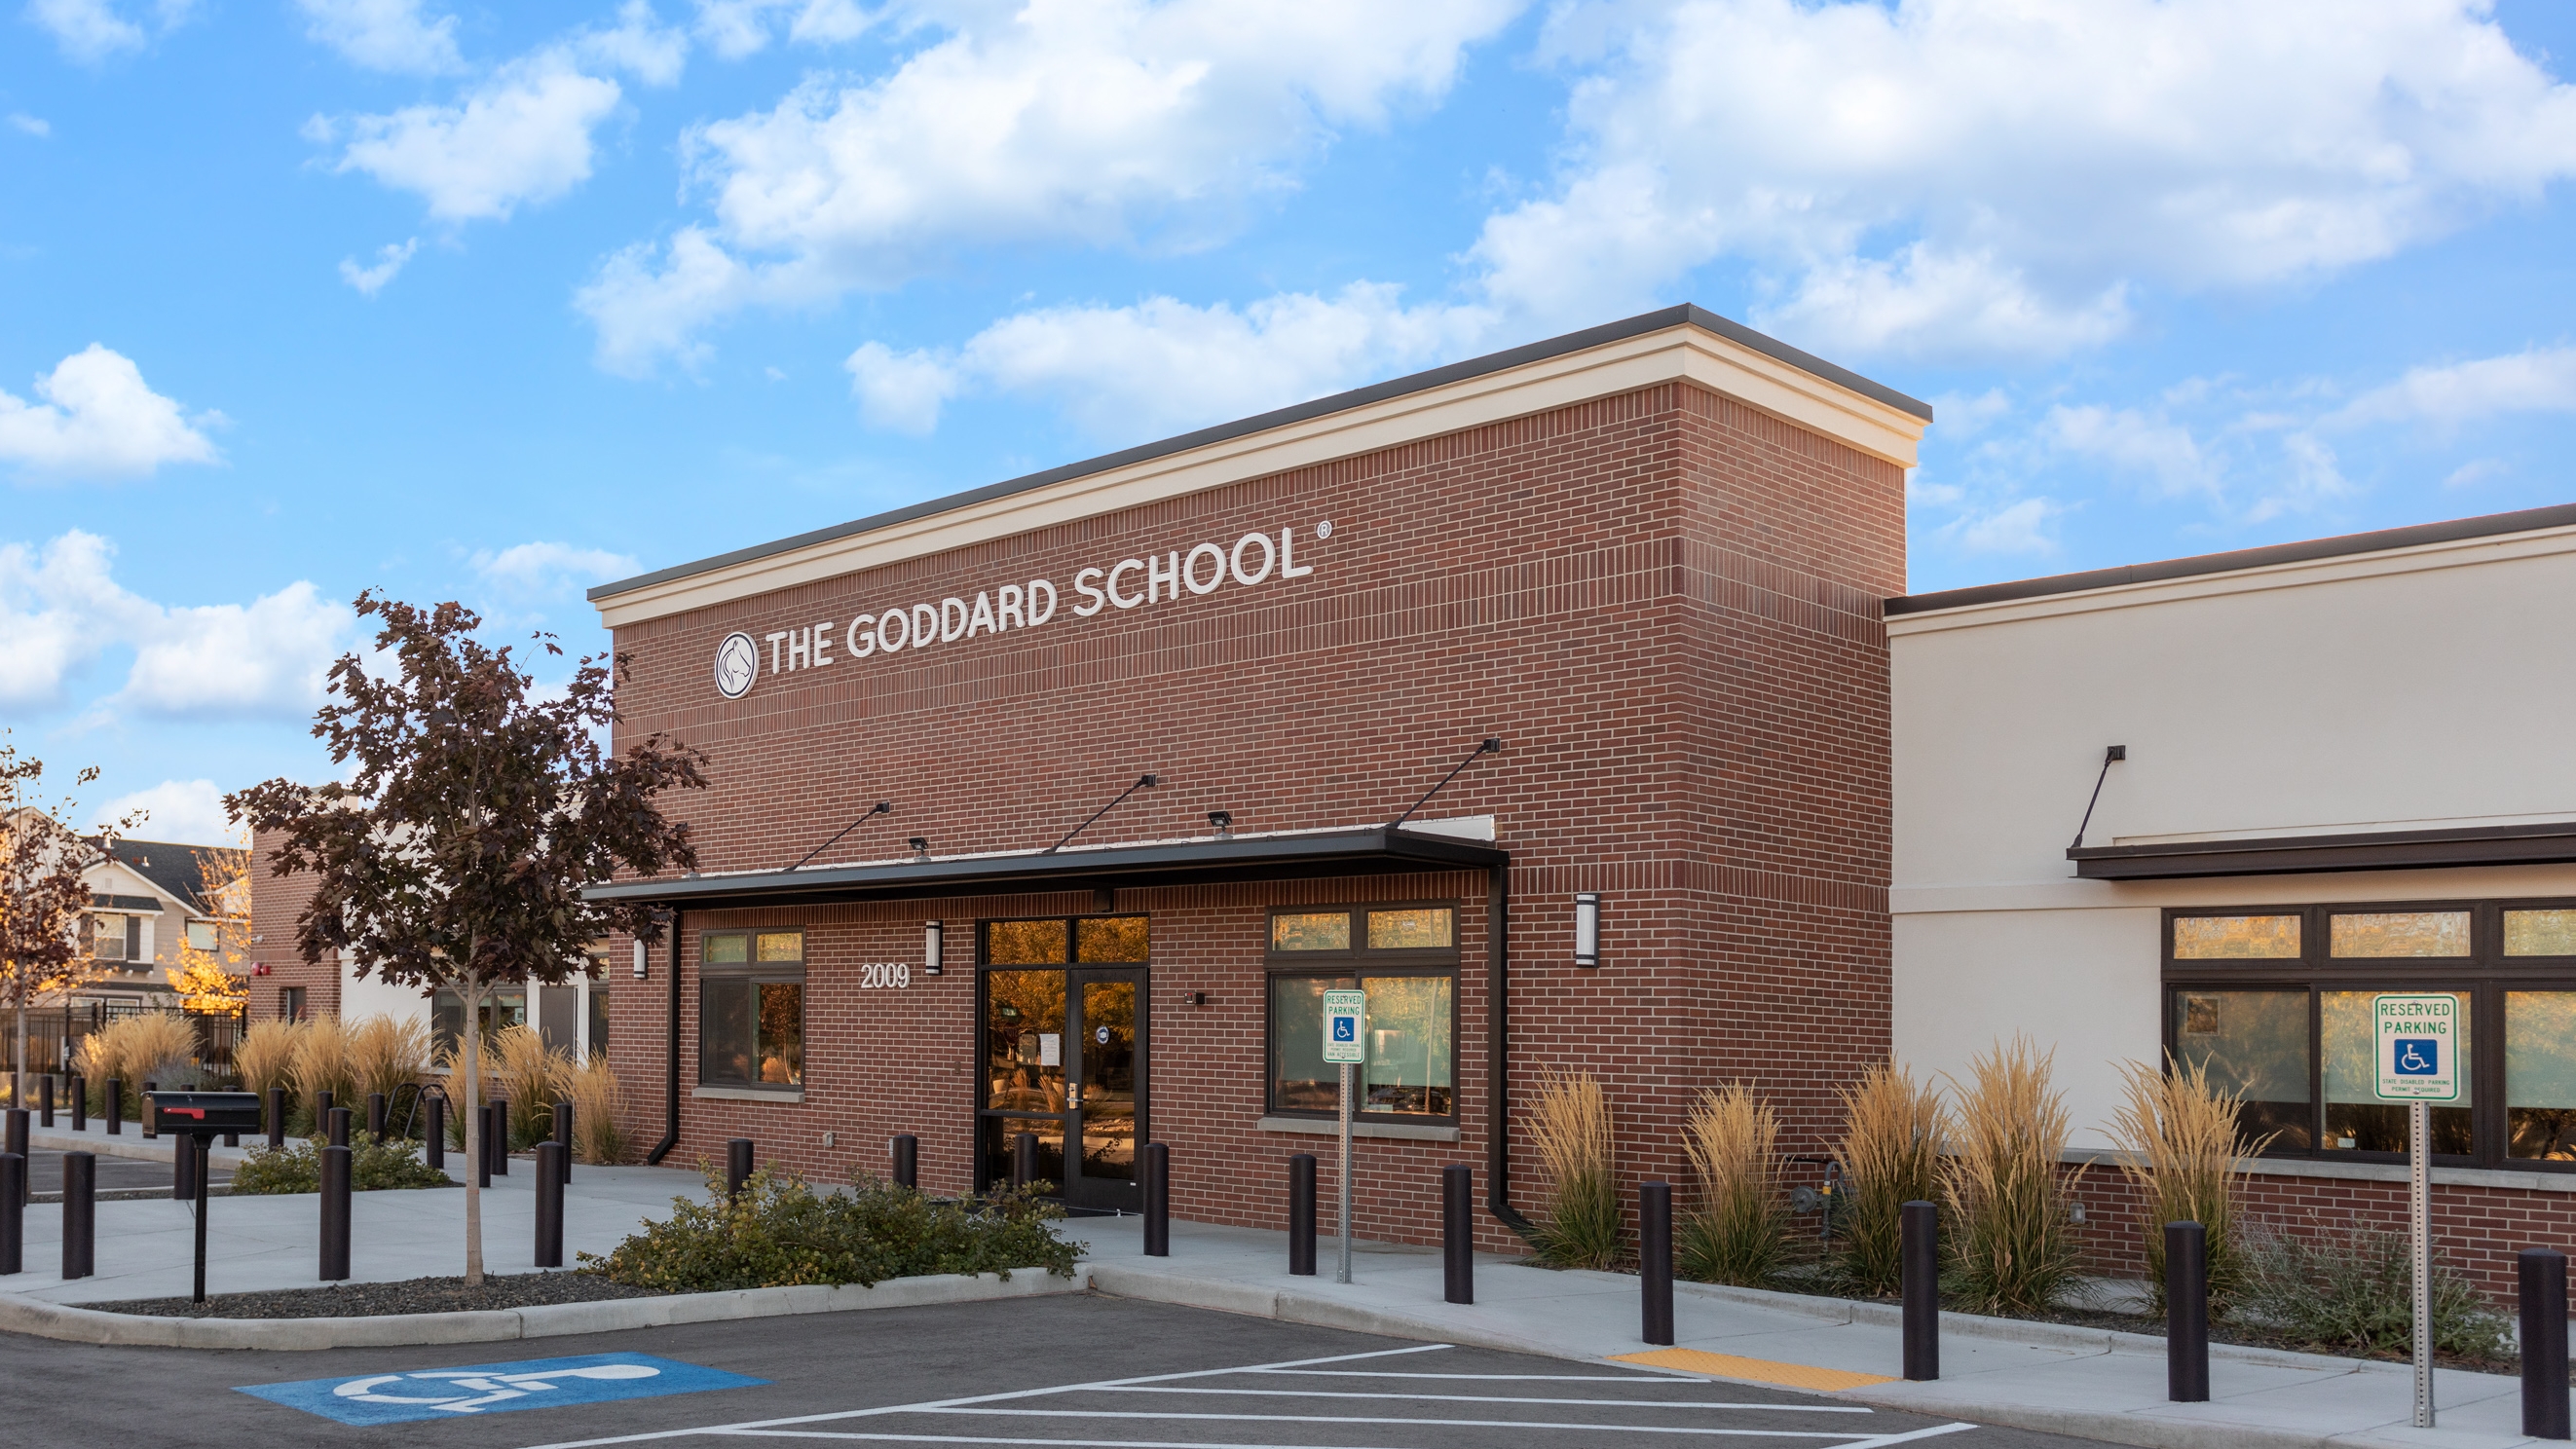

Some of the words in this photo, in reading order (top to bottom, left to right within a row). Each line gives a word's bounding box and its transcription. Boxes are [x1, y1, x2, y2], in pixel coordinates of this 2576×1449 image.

[765, 621, 835, 675] THE
[846, 578, 1058, 658] GODDARD
[1072, 527, 1314, 617] SCHOOL
[860, 962, 911, 988] 2009
[1327, 995, 1361, 1004] RESERVED
[2380, 1003, 2450, 1016] RESERVED
[2384, 1022, 2446, 1034] PARKING
